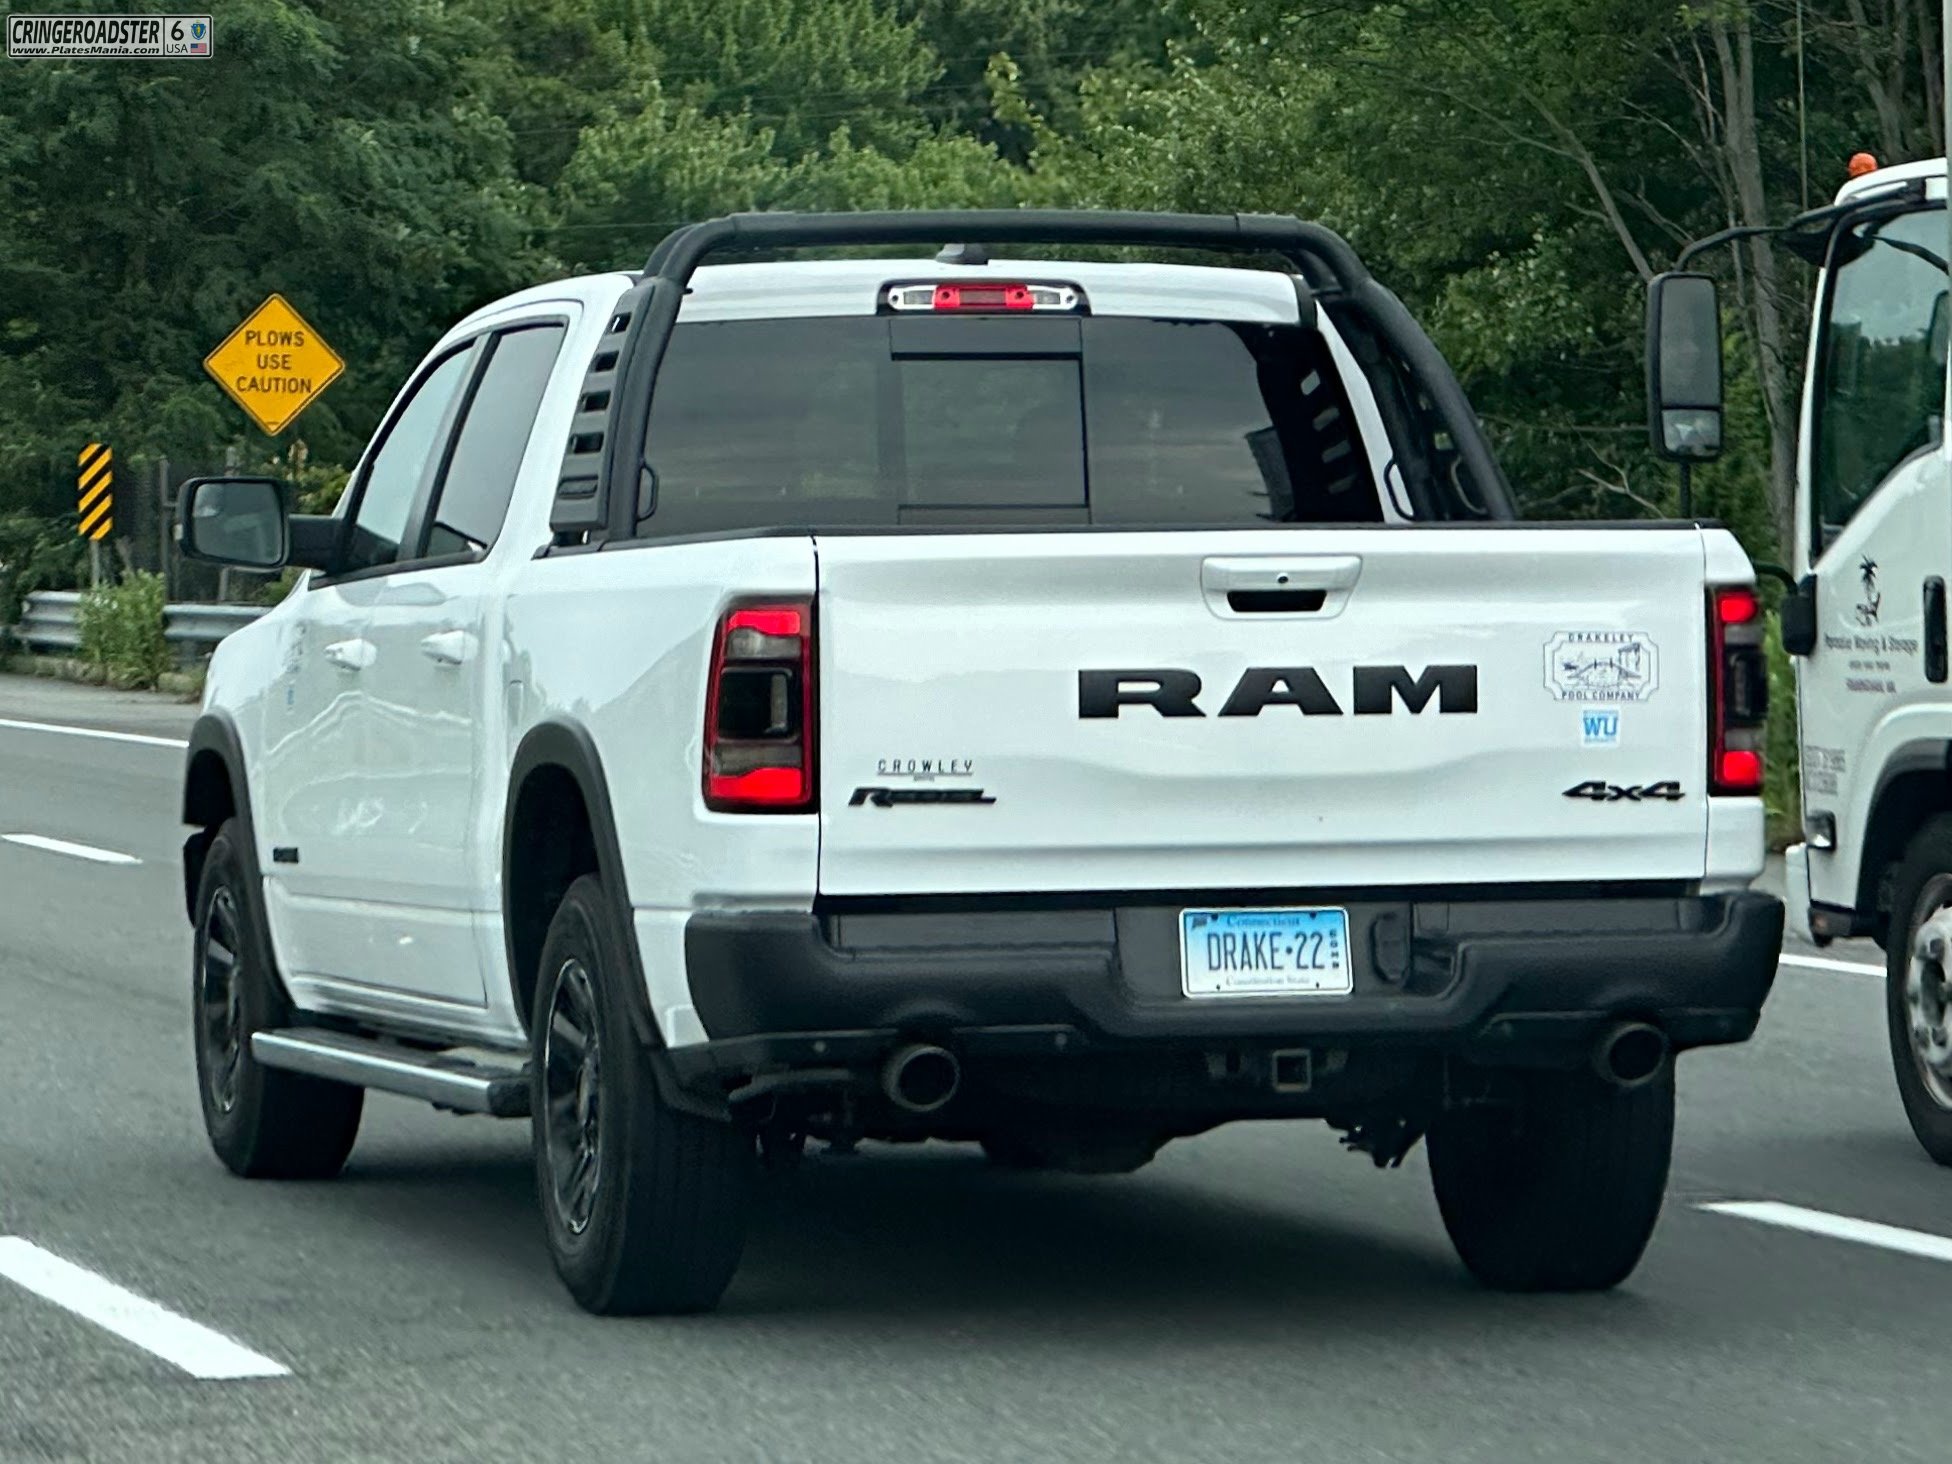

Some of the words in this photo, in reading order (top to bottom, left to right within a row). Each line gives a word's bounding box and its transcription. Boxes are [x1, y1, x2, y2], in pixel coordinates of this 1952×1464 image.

[245, 330, 305, 347] PLOWS
[257, 354, 292, 370] USE
[237, 376, 312, 394] CAUTION
[1568, 633, 1634, 643] DRAKELEY
[1078, 664, 1478, 719] RAM
[1561, 691, 1588, 701] POOL
[1592, 691, 1640, 701] COMPANY
[1583, 717, 1619, 736] WU
[878, 759, 973, 773] CROWLEY
[1562, 781, 1686, 801] 4x4
